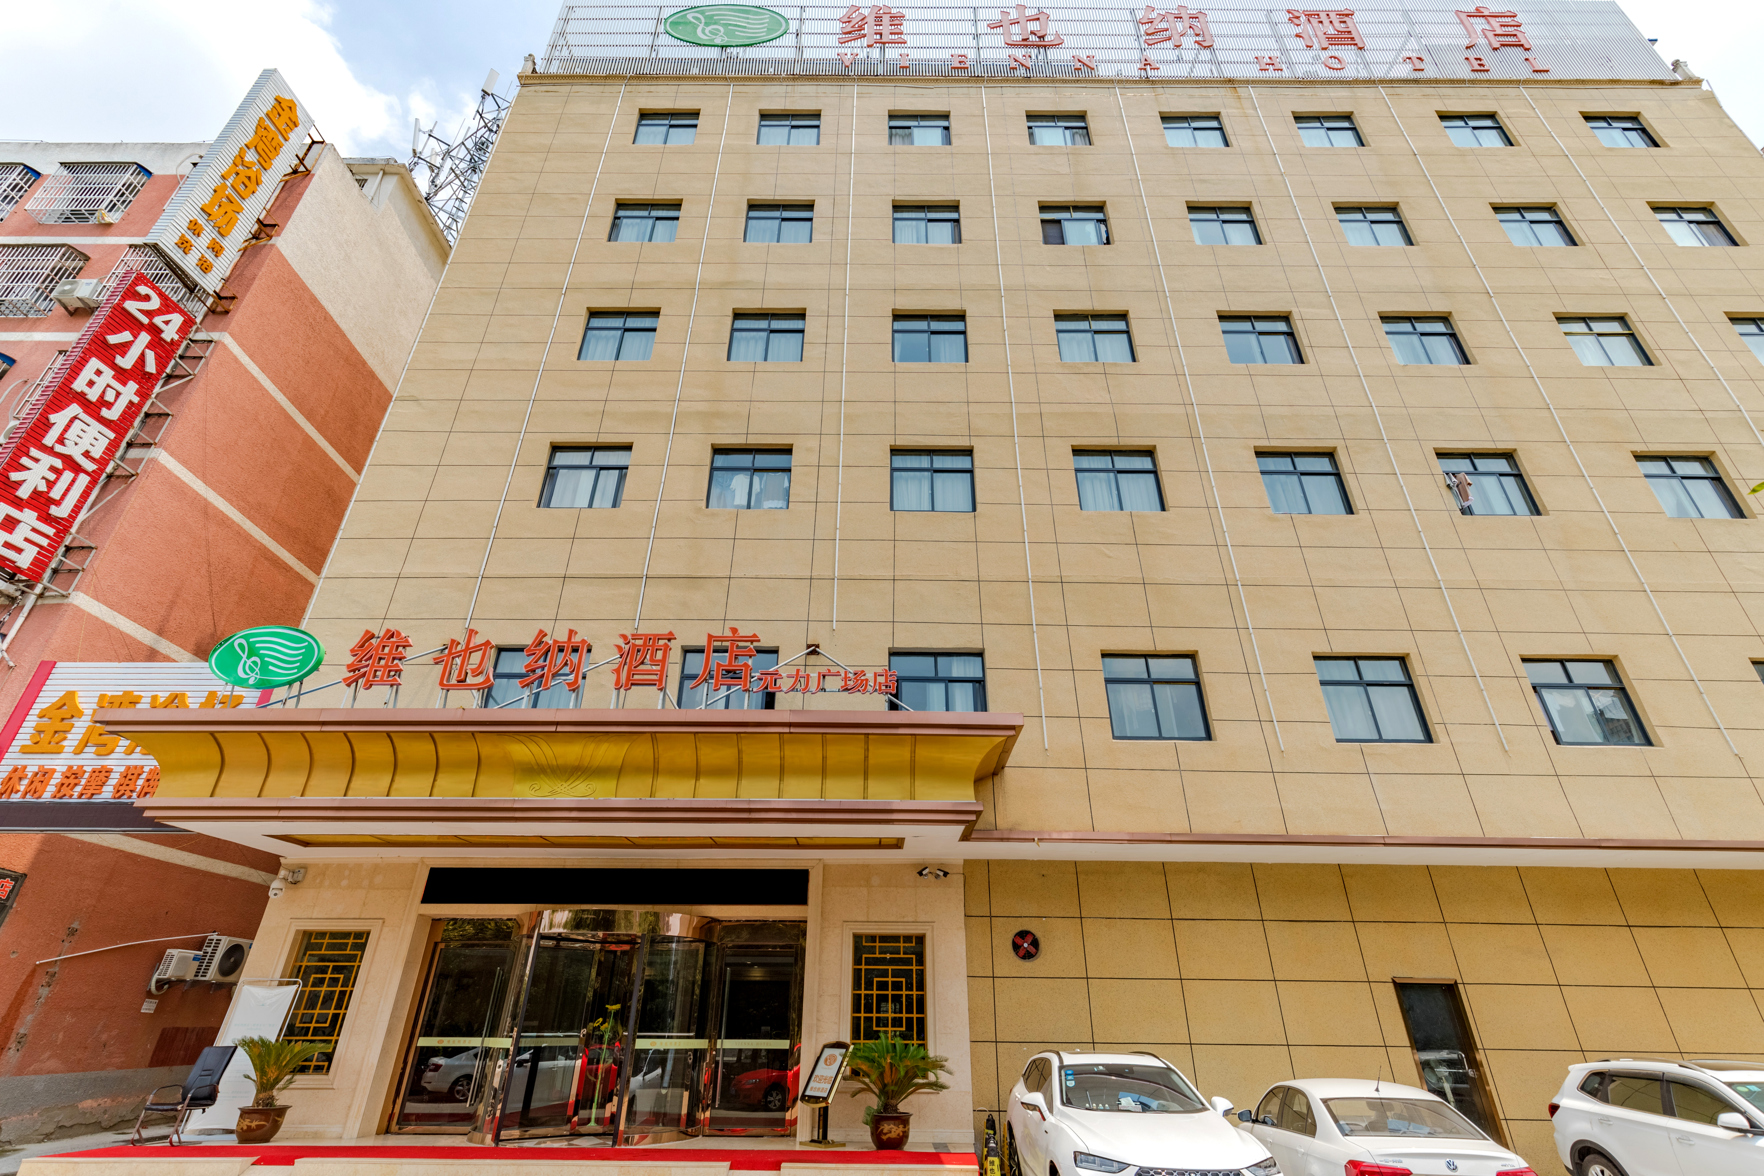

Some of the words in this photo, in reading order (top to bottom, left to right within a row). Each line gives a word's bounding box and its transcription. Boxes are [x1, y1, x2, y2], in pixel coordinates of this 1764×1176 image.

[837, 4, 1533, 52] 维也纳酒店
[837, 52, 1161, 71] VIENNA
[1253, 55, 1551, 74] HOTEL
[201, 94, 300, 237] 金湾浴场
[0, 285, 184, 570] 24小时便利店
[341, 626, 761, 691] 维也纳酒店
[752, 668, 898, 695] 元力广场店
